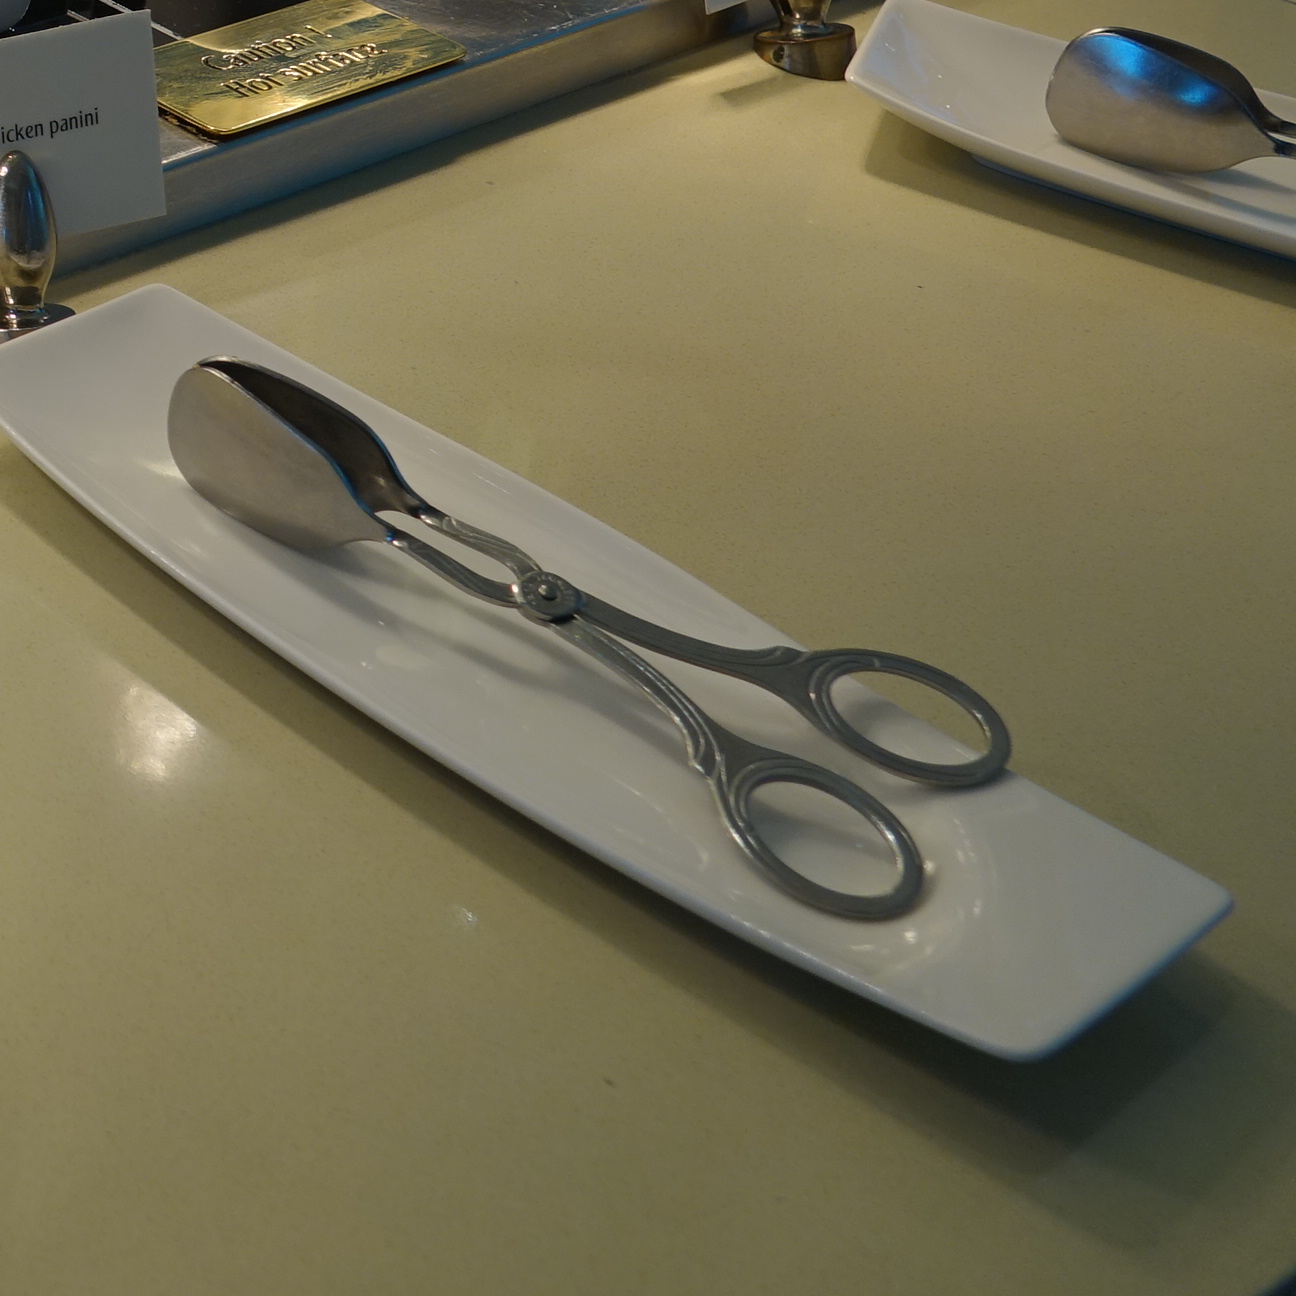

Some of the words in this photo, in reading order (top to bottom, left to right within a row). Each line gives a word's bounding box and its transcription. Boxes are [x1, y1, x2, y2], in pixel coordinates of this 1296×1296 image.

[201, 32, 317, 71] Caution
[220, 72, 285, 98] Hot
[49, 107, 100, 139] panini
